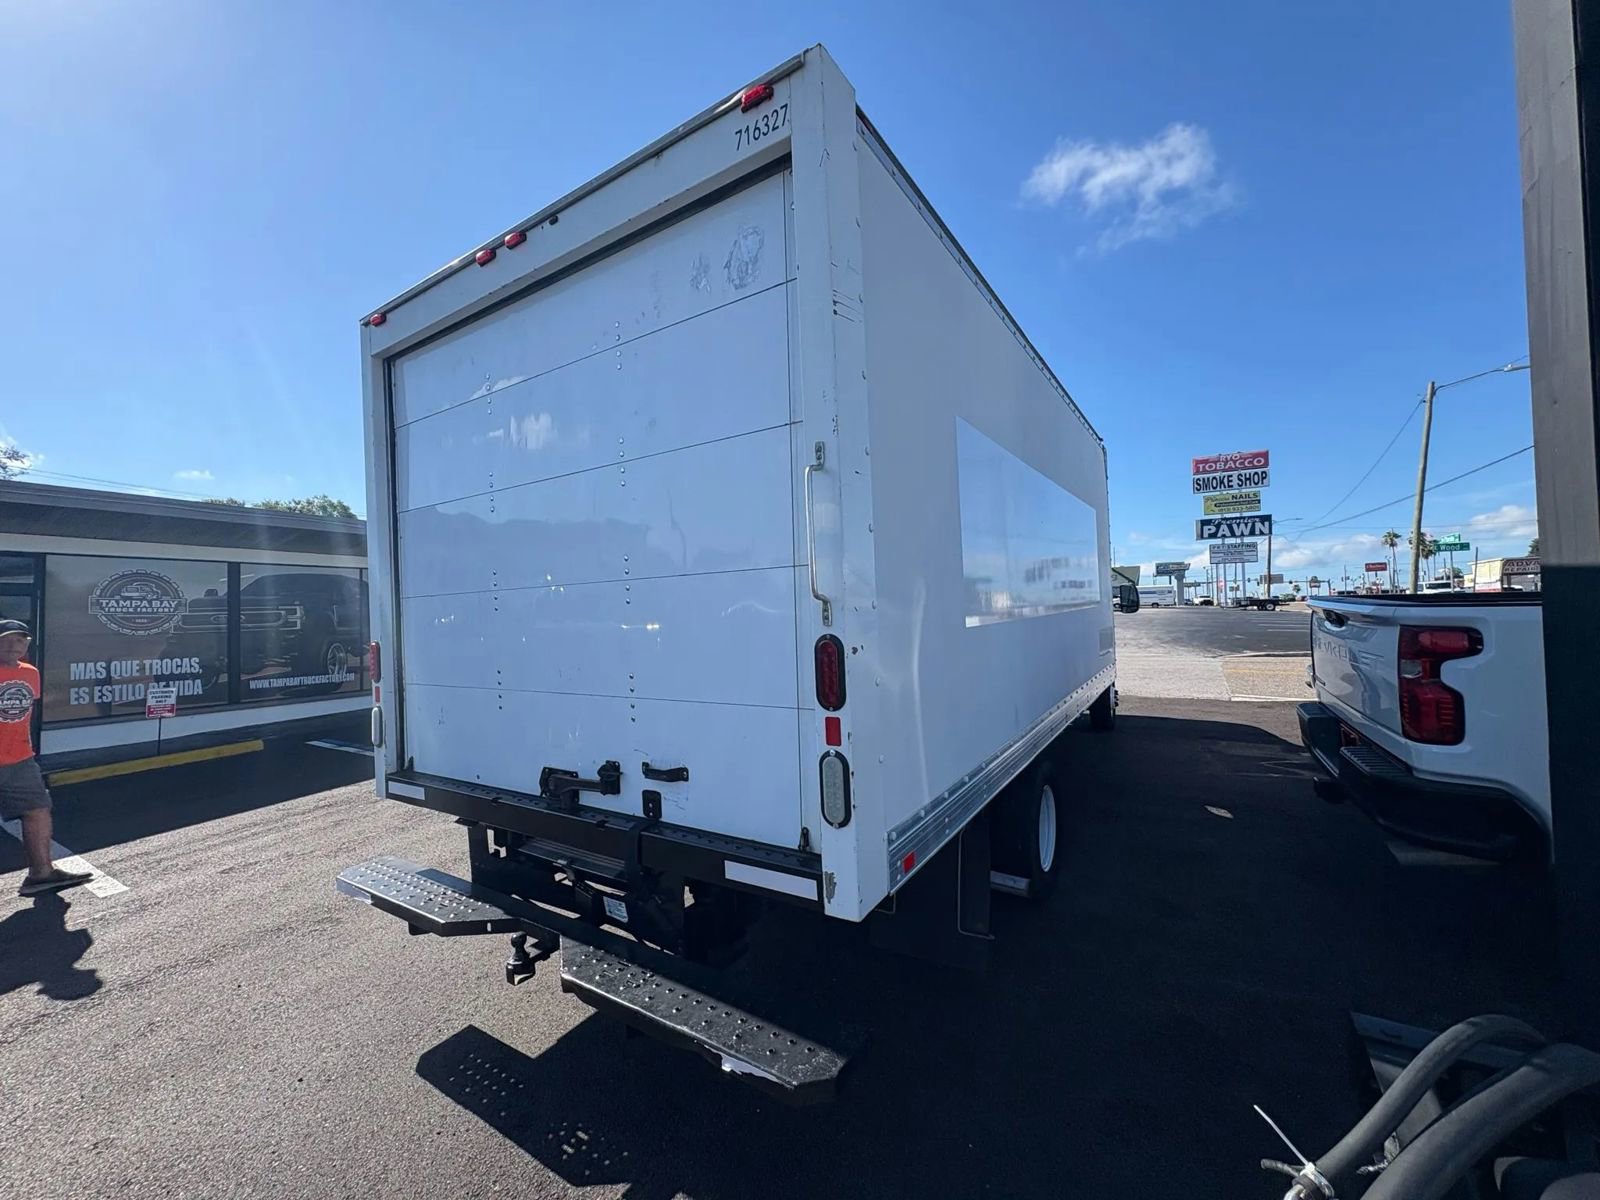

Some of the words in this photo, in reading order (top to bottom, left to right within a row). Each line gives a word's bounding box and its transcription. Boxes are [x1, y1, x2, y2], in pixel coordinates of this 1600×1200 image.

[735, 103, 788, 151] 716327
[1197, 457, 1264, 471] TOBACCO
[1220, 454, 1240, 462] RYO
[1195, 475, 1234, 492] SMOKE
[1237, 470, 1268, 487] SHOP
[1231, 492, 1258, 501] NAILS
[1210, 518, 1260, 526] Premier
[1203, 522, 1269, 538] PAWN
[1440, 543, 1461, 551] Wood
[100, 600, 149, 608] TAMPA
[152, 600, 178, 608] BAY
[70, 661, 107, 681] MAS
[110, 660, 140, 680] QUE
[143, 657, 203, 676] TROCAS,
[70, 687, 90, 705] ES
[93, 683, 145, 703] ESTILO
[170, 679, 203, 697] VIDA
